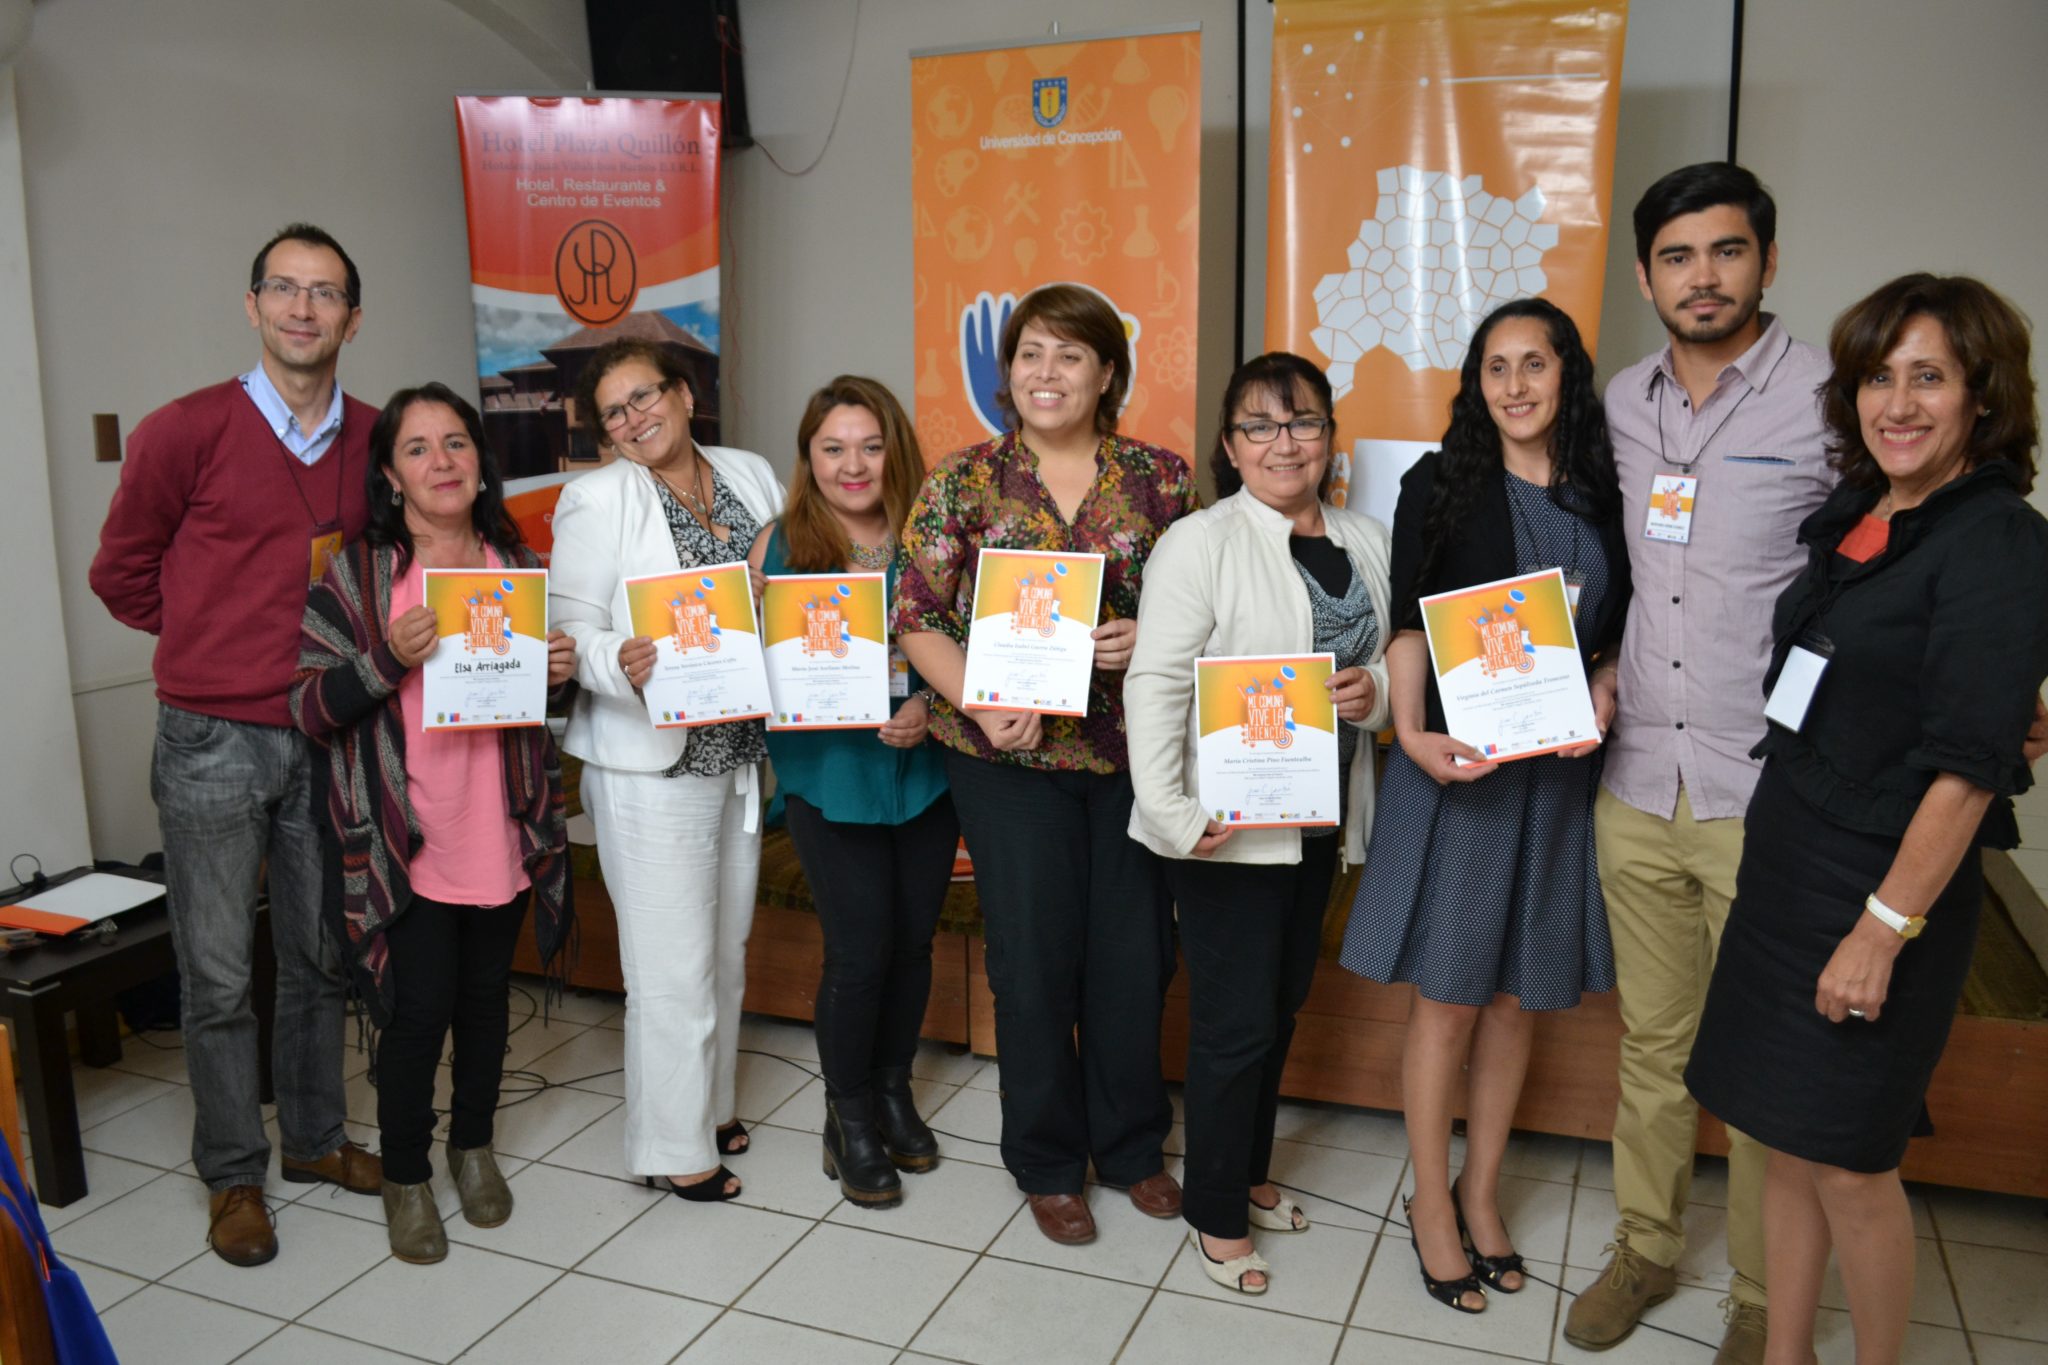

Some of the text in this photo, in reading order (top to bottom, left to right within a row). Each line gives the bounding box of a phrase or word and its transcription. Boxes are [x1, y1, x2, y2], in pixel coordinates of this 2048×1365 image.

[482, 132, 701, 159] Hotel Plaza Quillón
[980, 128, 1122, 150] Universidad de Concepción
[517, 178, 666, 192] Hotel, Restaurante &
[527, 194, 661, 208] Centro de Eventos
[471, 606, 503, 617] MI COMUNA
[471, 618, 503, 634] VIVE LA
[1481, 621, 1518, 638] MI COMUNA
[471, 635, 504, 648] CIENCIA
[1484, 633, 1522, 656] VIVE LA
[455, 659, 521, 673] Elsa Arriagada
[1488, 651, 1525, 670] CIENCIA
[1248, 695, 1284, 708] MI COMUNA
[1248, 708, 1284, 726] VIVE LA
[1249, 727, 1285, 740] CIENCIA
